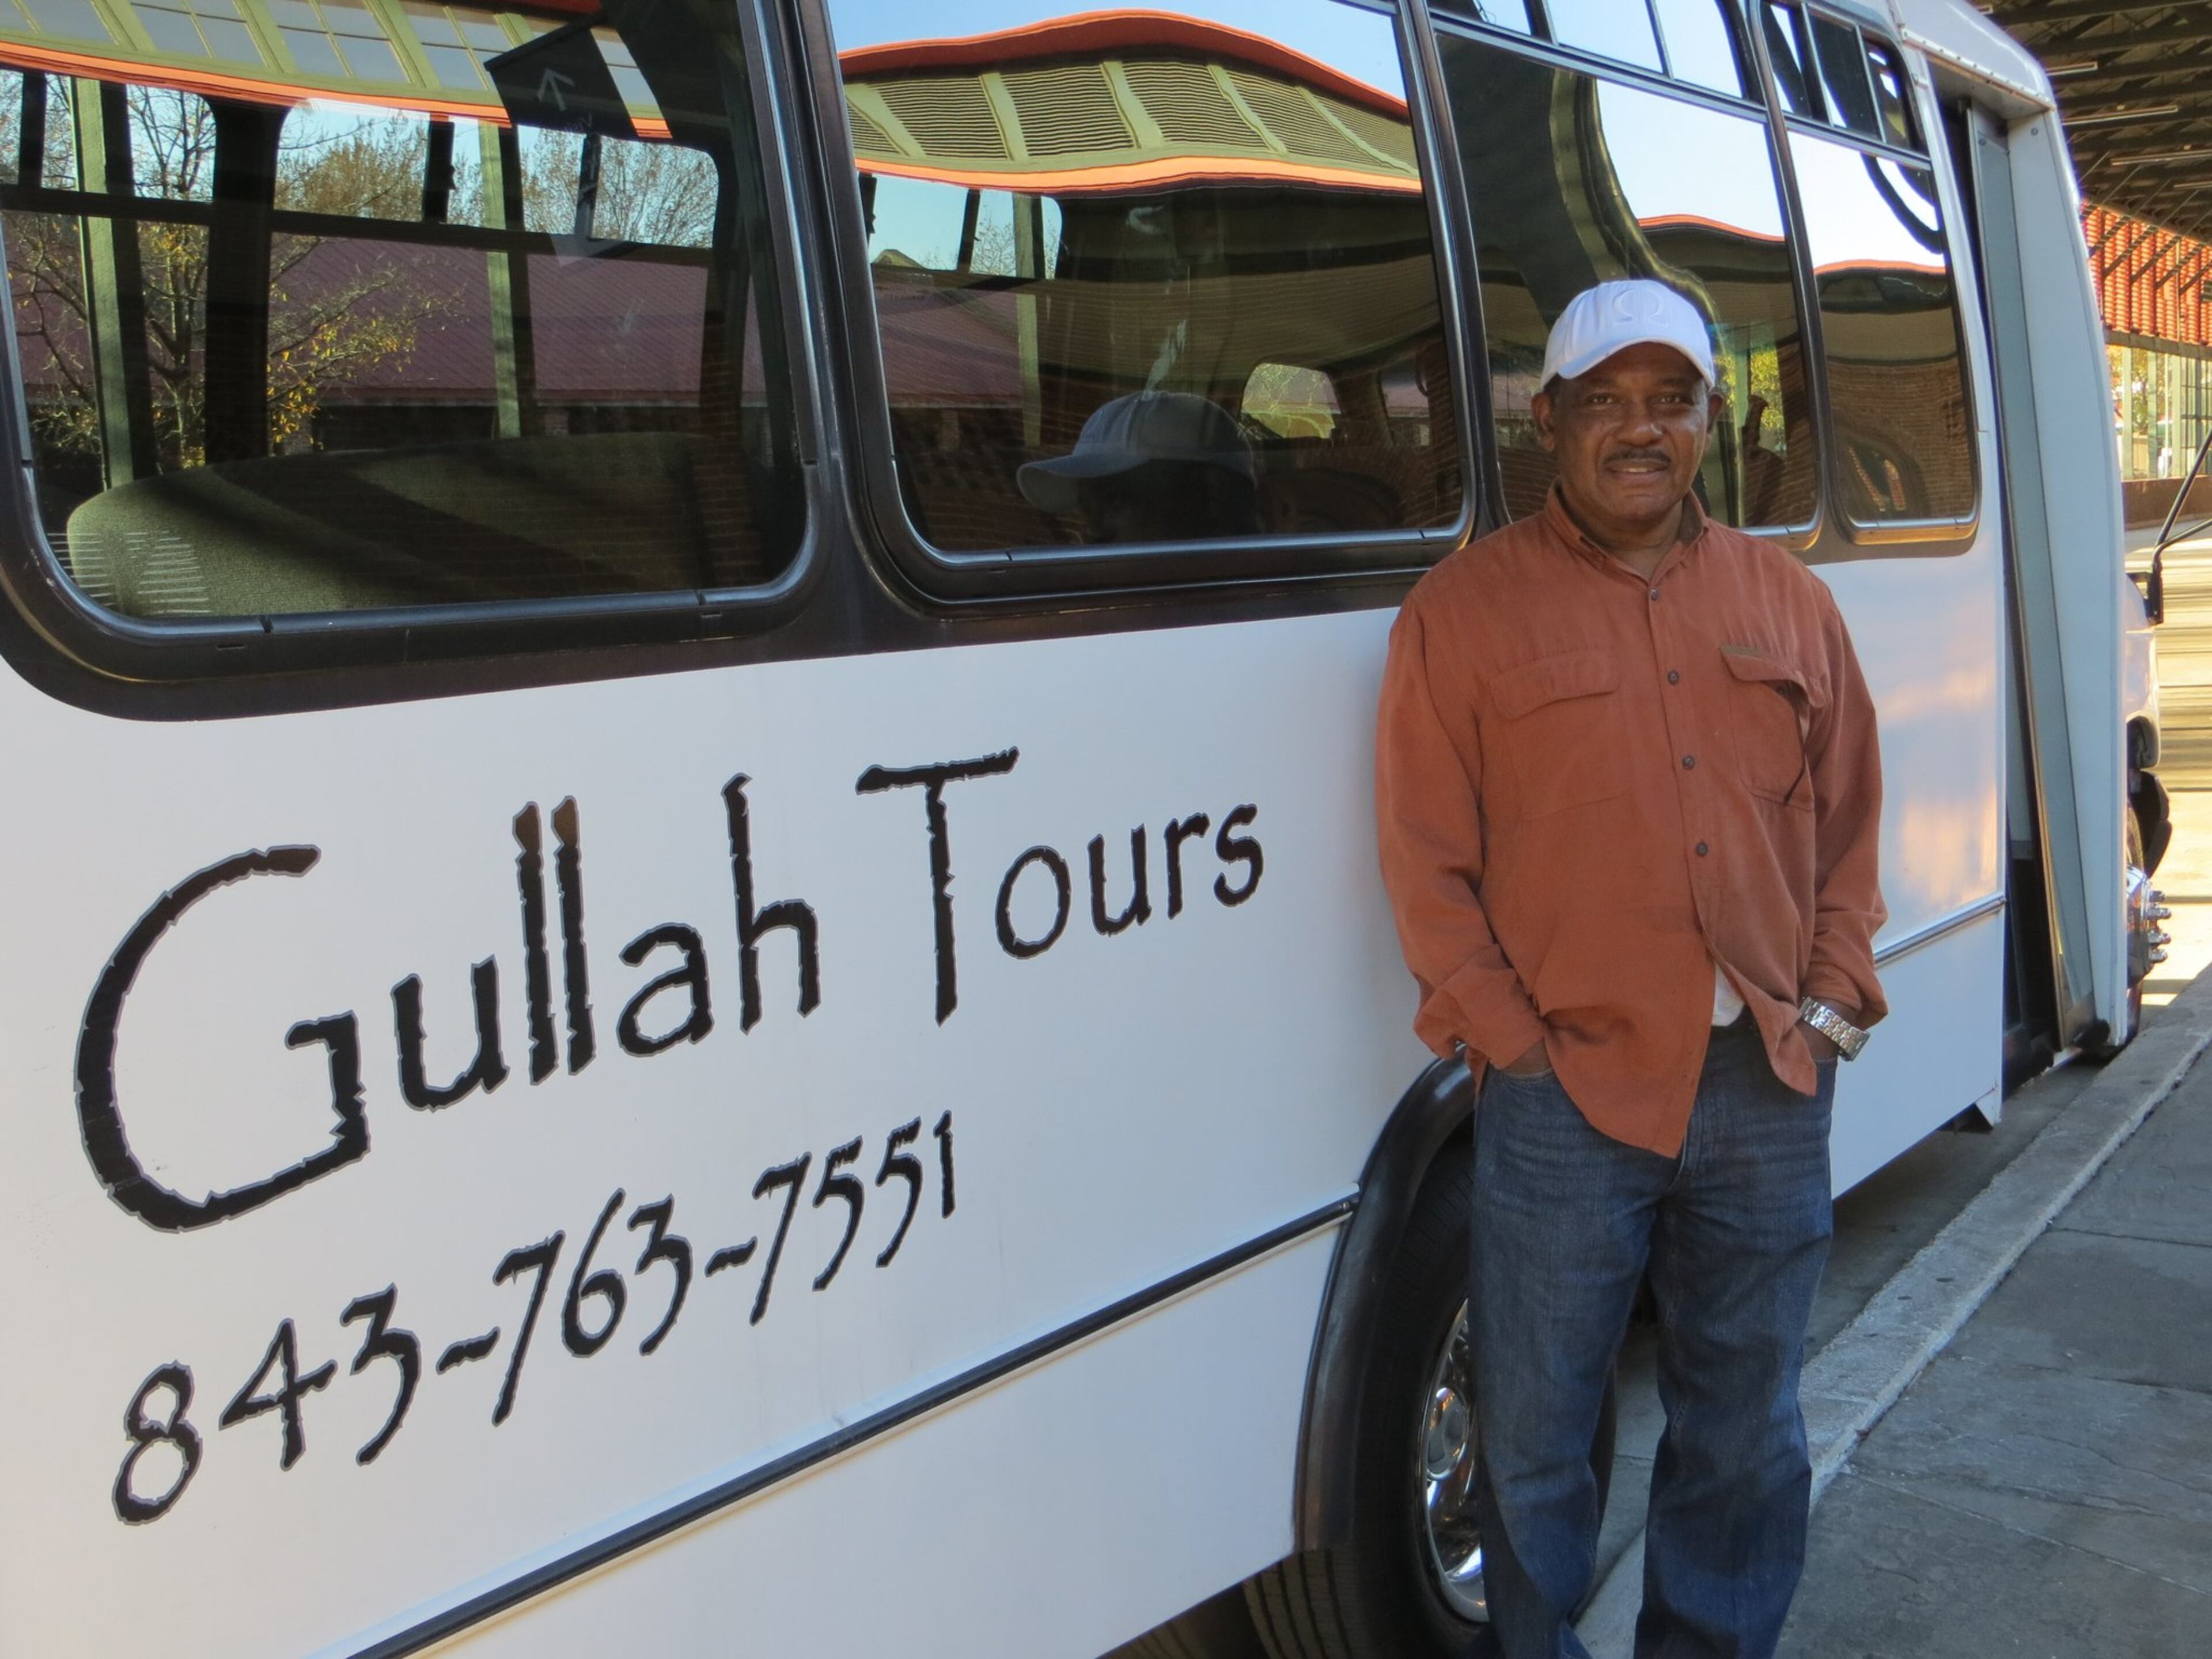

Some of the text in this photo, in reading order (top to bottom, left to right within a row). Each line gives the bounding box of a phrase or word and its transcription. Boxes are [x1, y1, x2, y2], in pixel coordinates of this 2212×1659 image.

[74, 746, 1264, 1233] Gullah Tours
[112, 1109, 957, 1525] 843-763-7551
